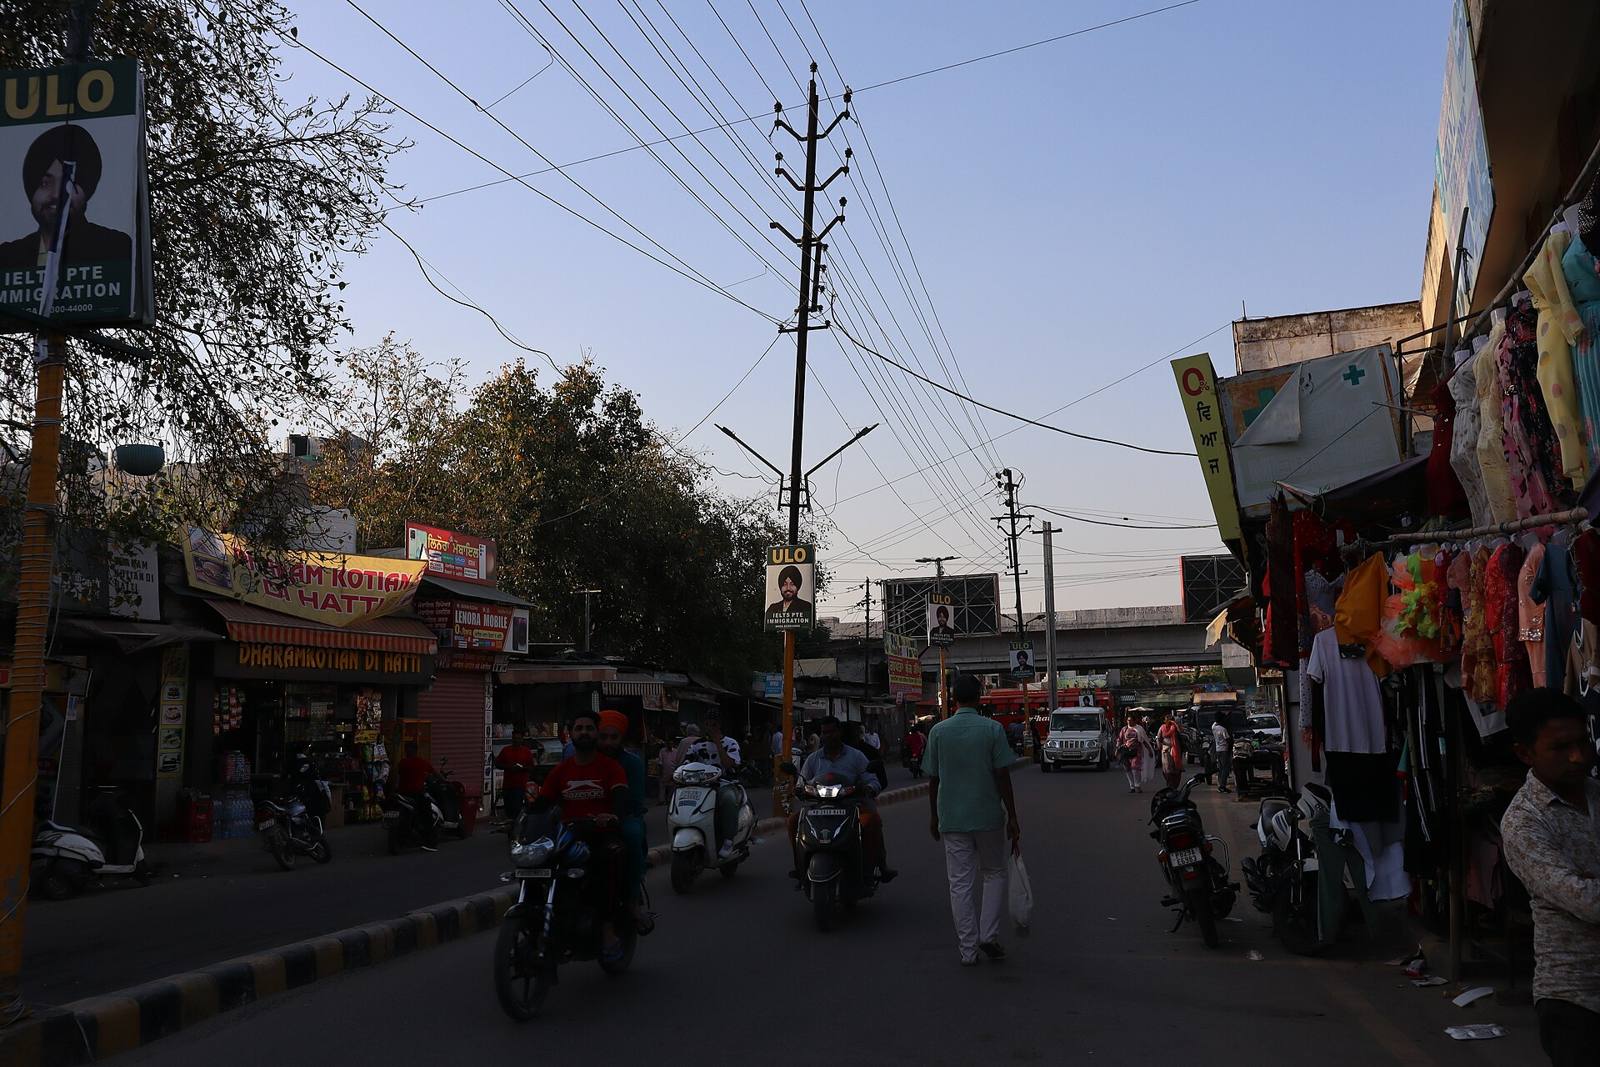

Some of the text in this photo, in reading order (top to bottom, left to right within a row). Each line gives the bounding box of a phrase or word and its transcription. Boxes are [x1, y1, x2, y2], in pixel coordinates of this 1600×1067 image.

[5, 69, 115, 120] ULO
[5, 265, 105, 287] IELT PTE
[772, 547, 807, 564] ULO
[933, 594, 951, 605] ULO
[455, 609, 481, 627] LENORA
[483, 613, 508, 629] MOBILE
[767, 617, 809, 625] IMMIGRATION
[1012, 641, 1029, 650] ULO
[383, 653, 421, 673] HATTI
